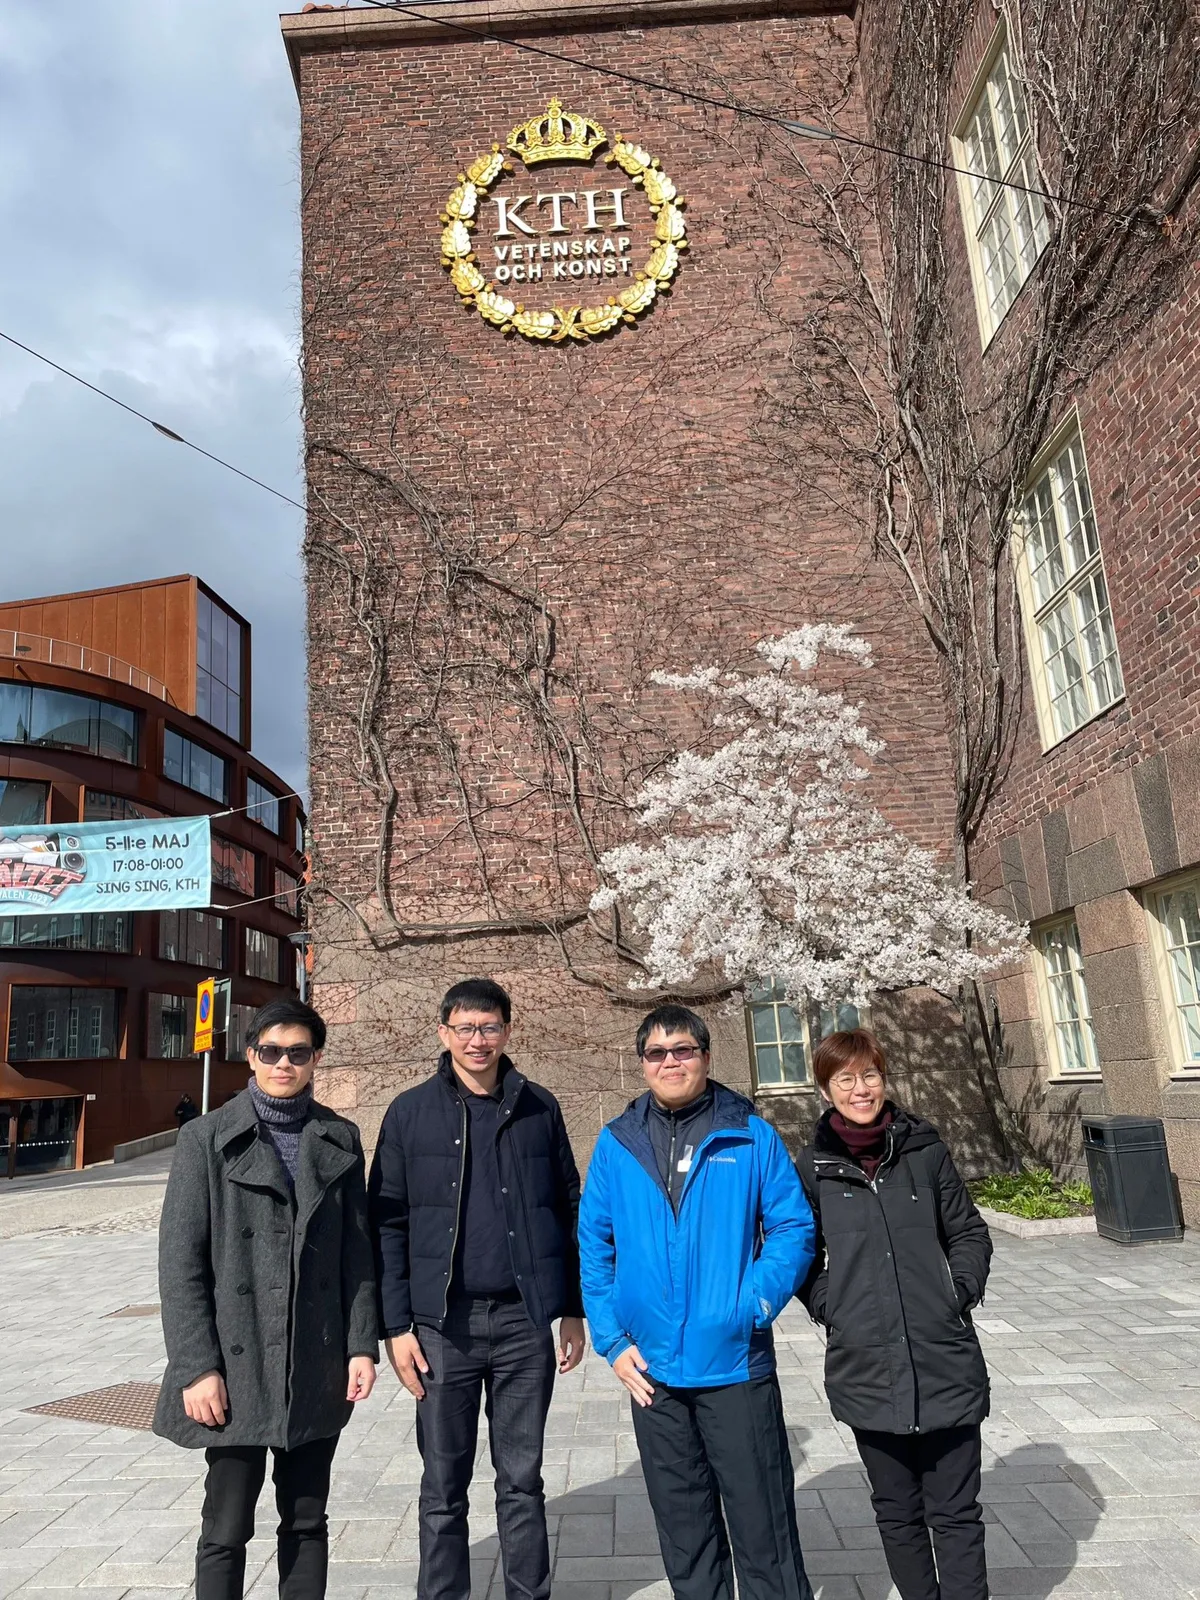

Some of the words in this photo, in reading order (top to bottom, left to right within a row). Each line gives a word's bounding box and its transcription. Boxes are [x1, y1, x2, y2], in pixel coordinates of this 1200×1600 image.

[491, 188, 630, 237] KTH
[494, 237, 630, 260] VETENSKAP
[495, 264, 542, 281] OCH
[554, 257, 631, 277] KONST
[152, 833, 190, 849] MAJ
[113, 857, 184, 872] 17:08-01:00
[96, 881, 130, 894] SING
[135, 879, 172, 892] SING,
[176, 878, 200, 890] KTH
[27, 891, 48, 904] 2023
[712, 1155, 736, 1163] Columbia
